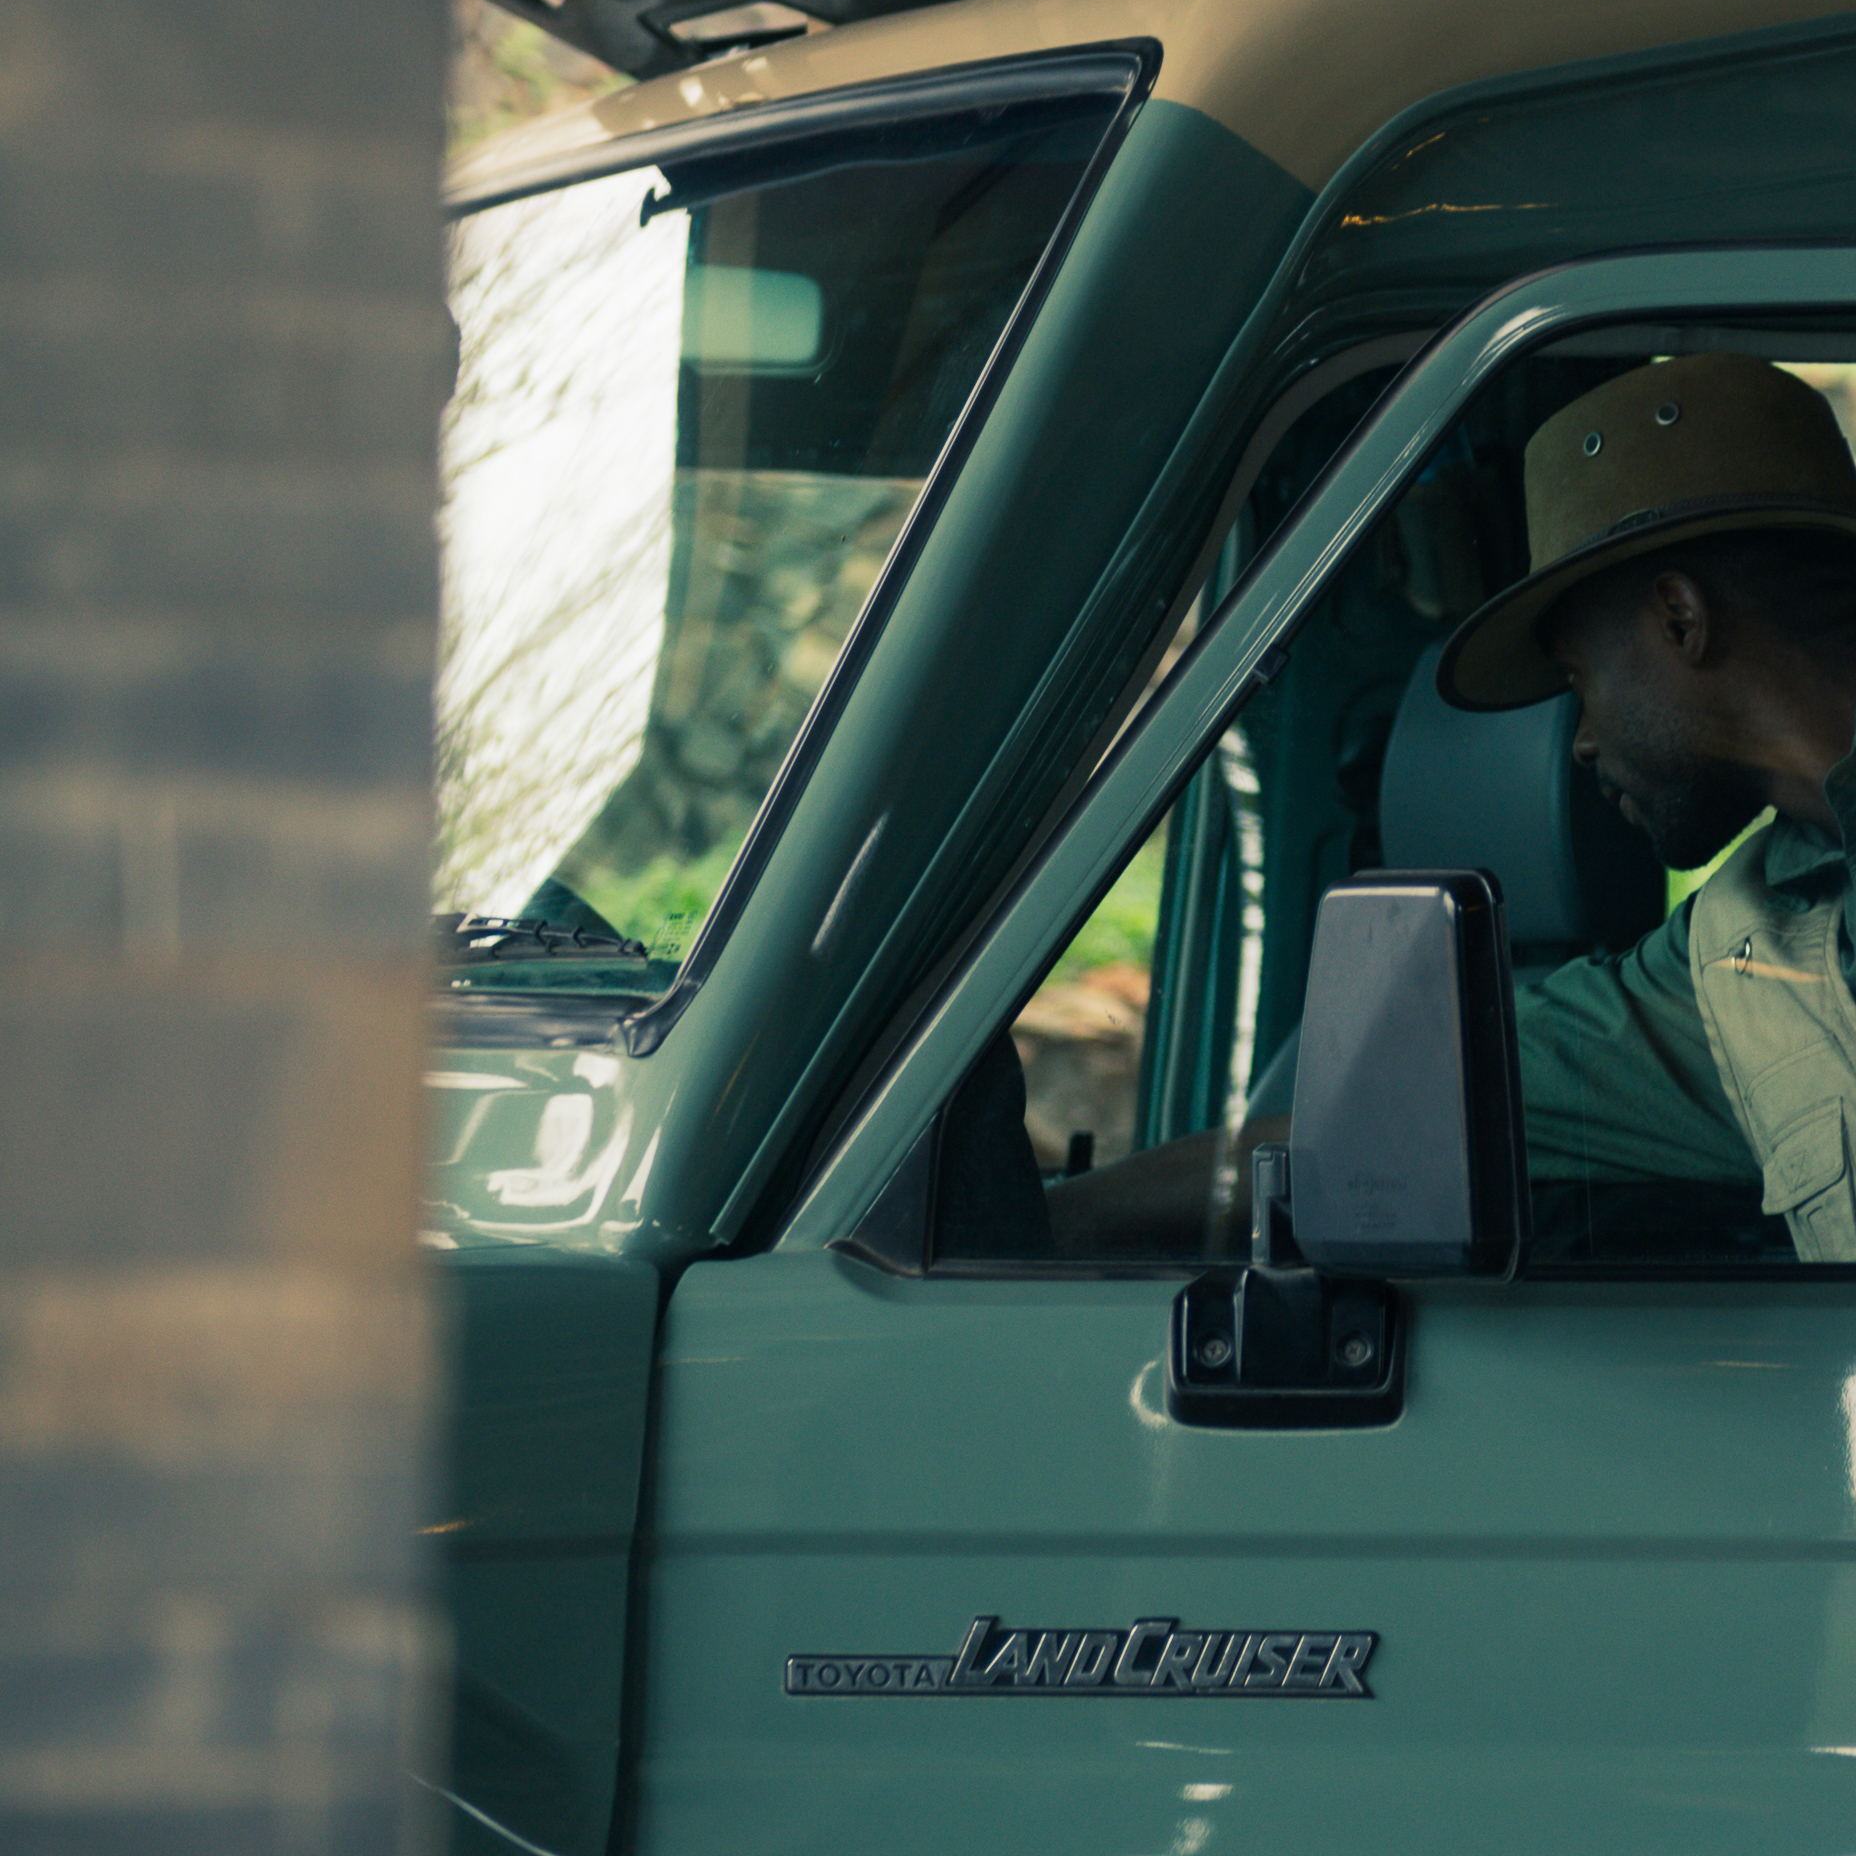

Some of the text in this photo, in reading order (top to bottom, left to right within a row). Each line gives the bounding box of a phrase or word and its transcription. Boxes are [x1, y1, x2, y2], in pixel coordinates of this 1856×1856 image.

[796, 1618, 1372, 1692] TOYOTA LAND CRUISER
